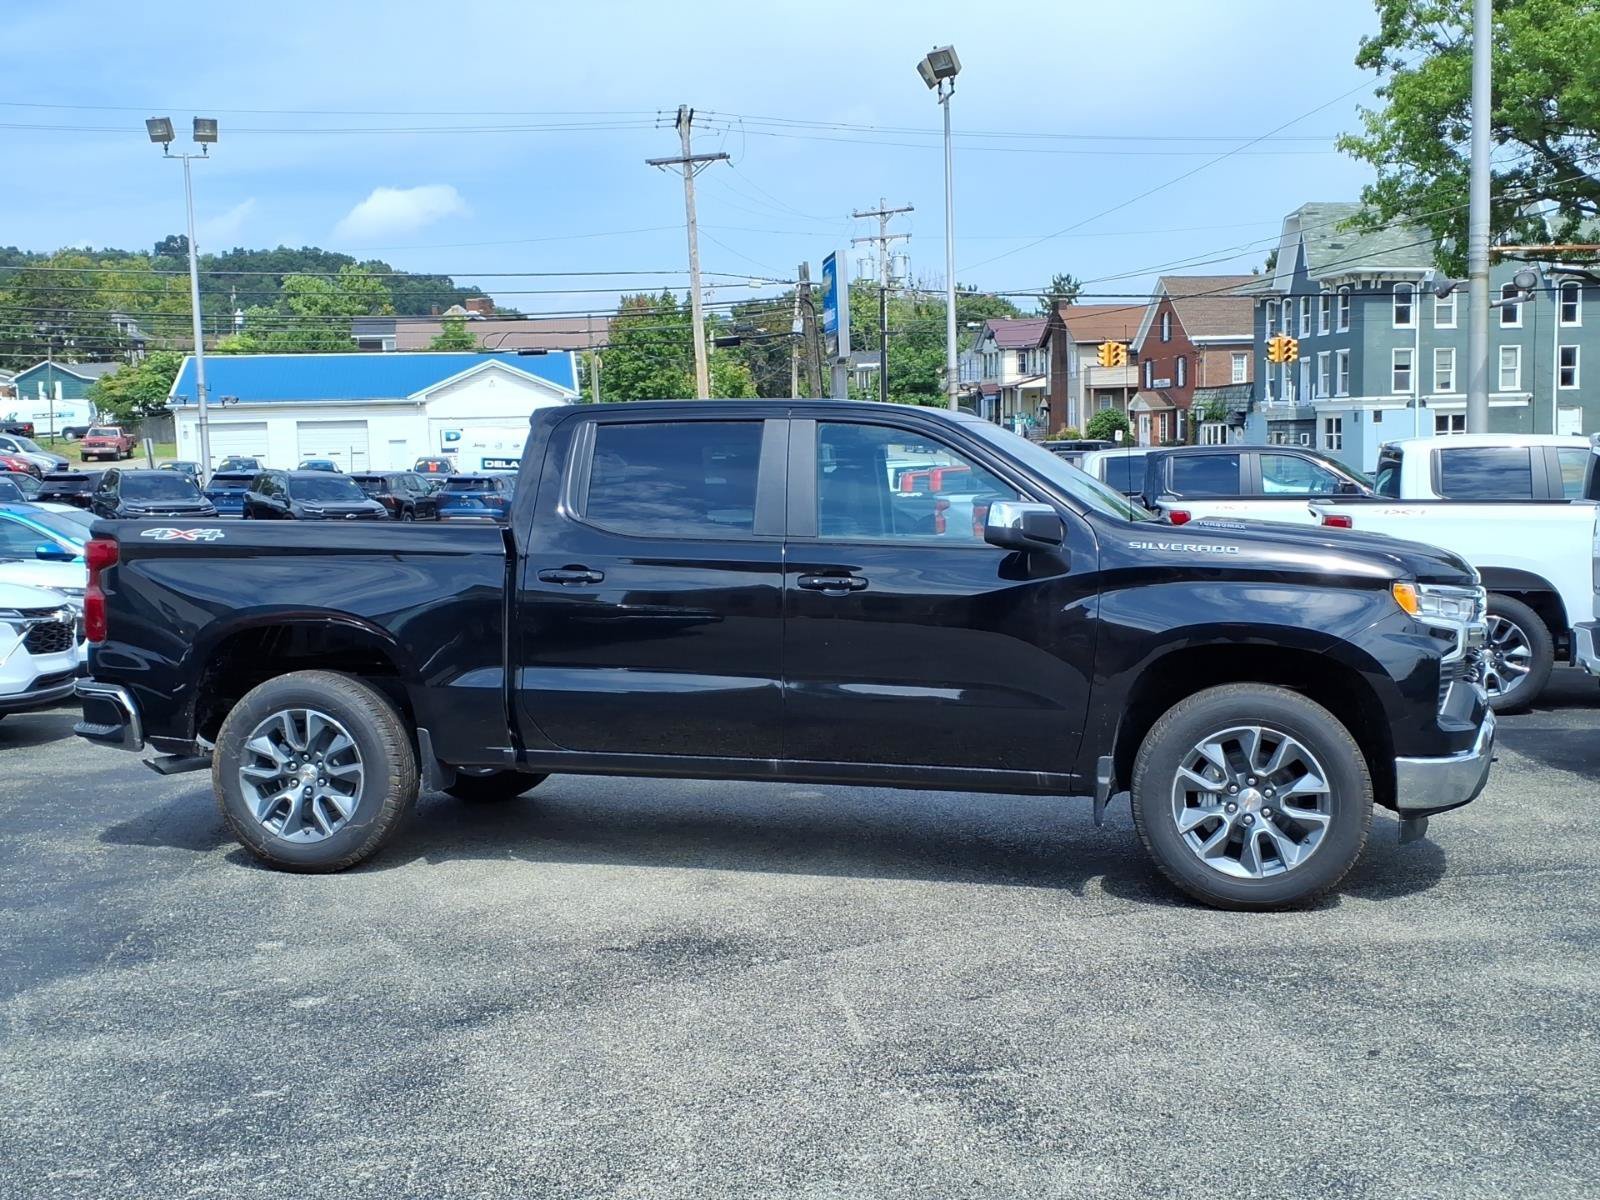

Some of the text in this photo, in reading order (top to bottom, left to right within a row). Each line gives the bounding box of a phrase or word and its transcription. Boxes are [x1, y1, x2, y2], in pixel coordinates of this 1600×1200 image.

[484, 460, 521, 468] DELA
[140, 527, 226, 541] 4X4
[1127, 541, 1240, 554] SILVERADO
